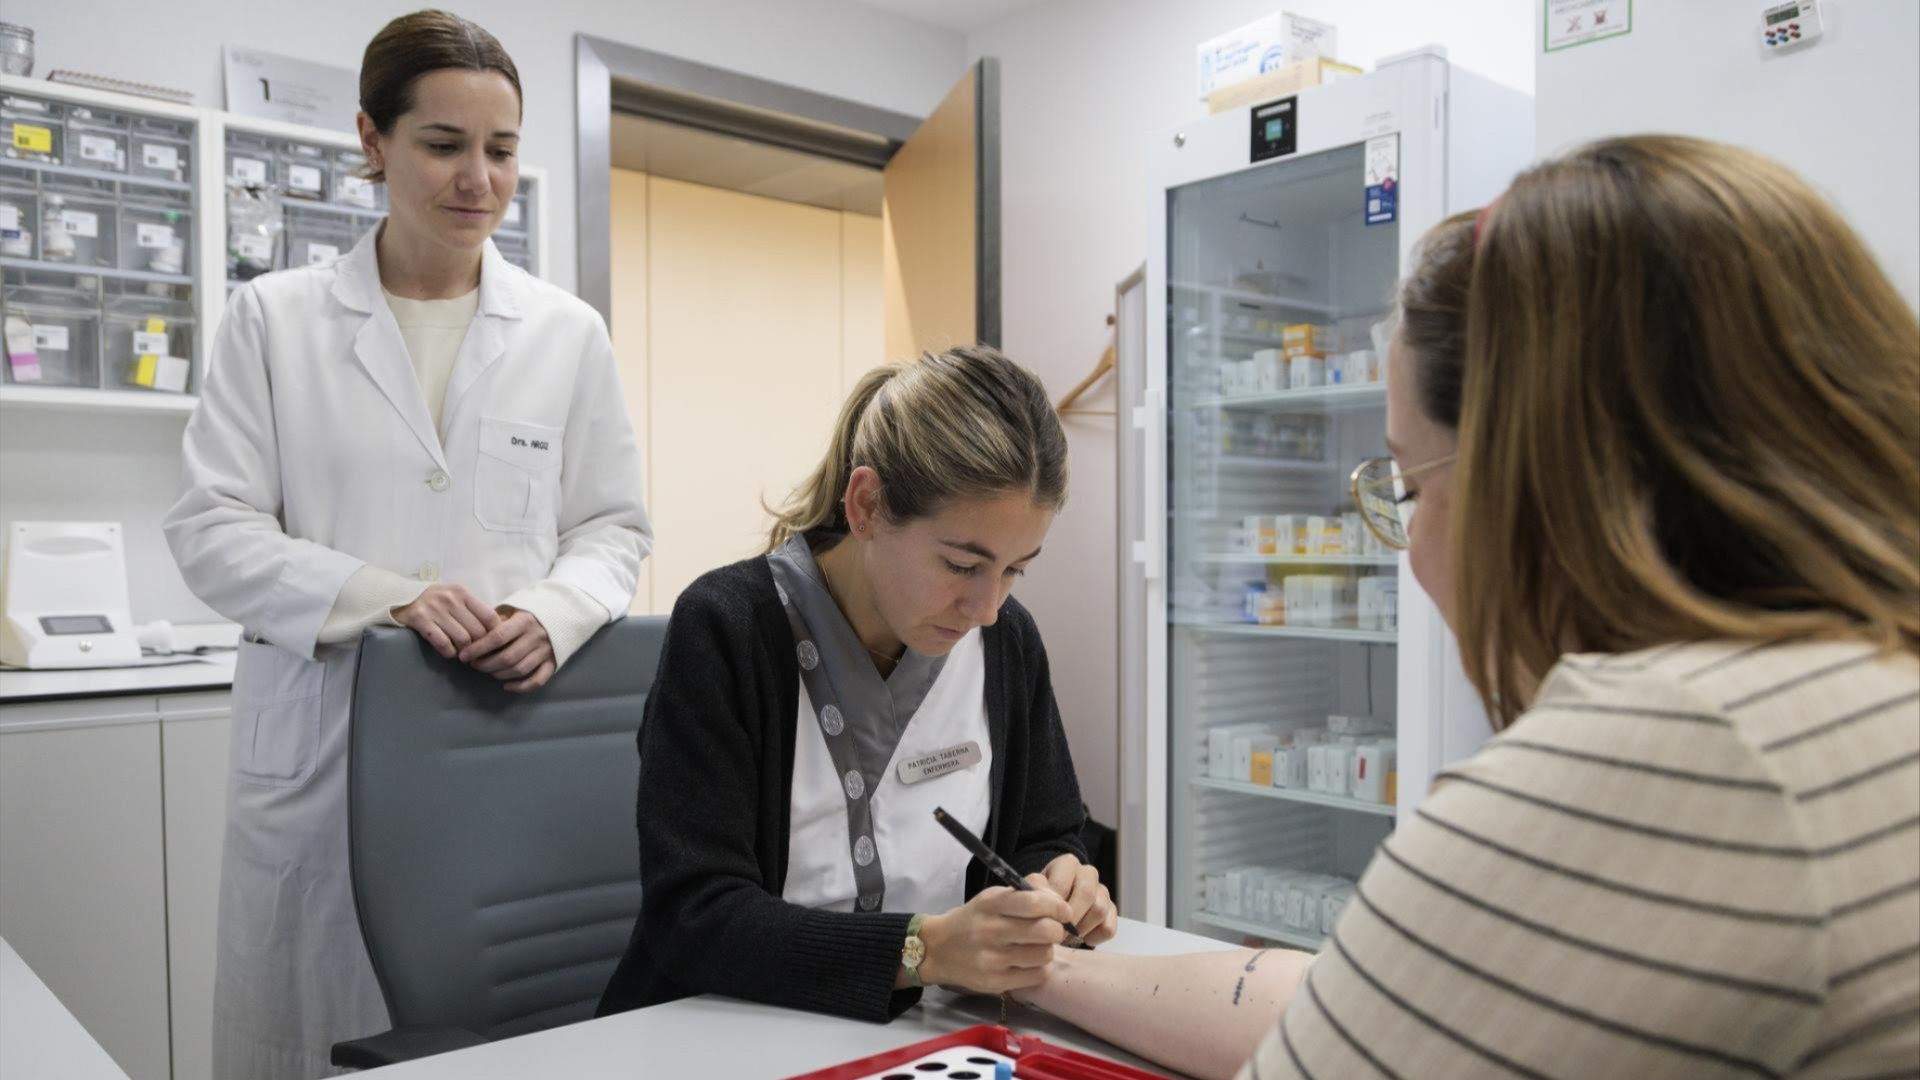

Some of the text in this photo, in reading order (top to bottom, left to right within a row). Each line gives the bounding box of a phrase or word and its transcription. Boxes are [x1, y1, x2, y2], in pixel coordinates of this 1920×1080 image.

[907, 746, 969, 770] PATRICIA TABERNA
[923, 760, 960, 775] ENFERMERA
